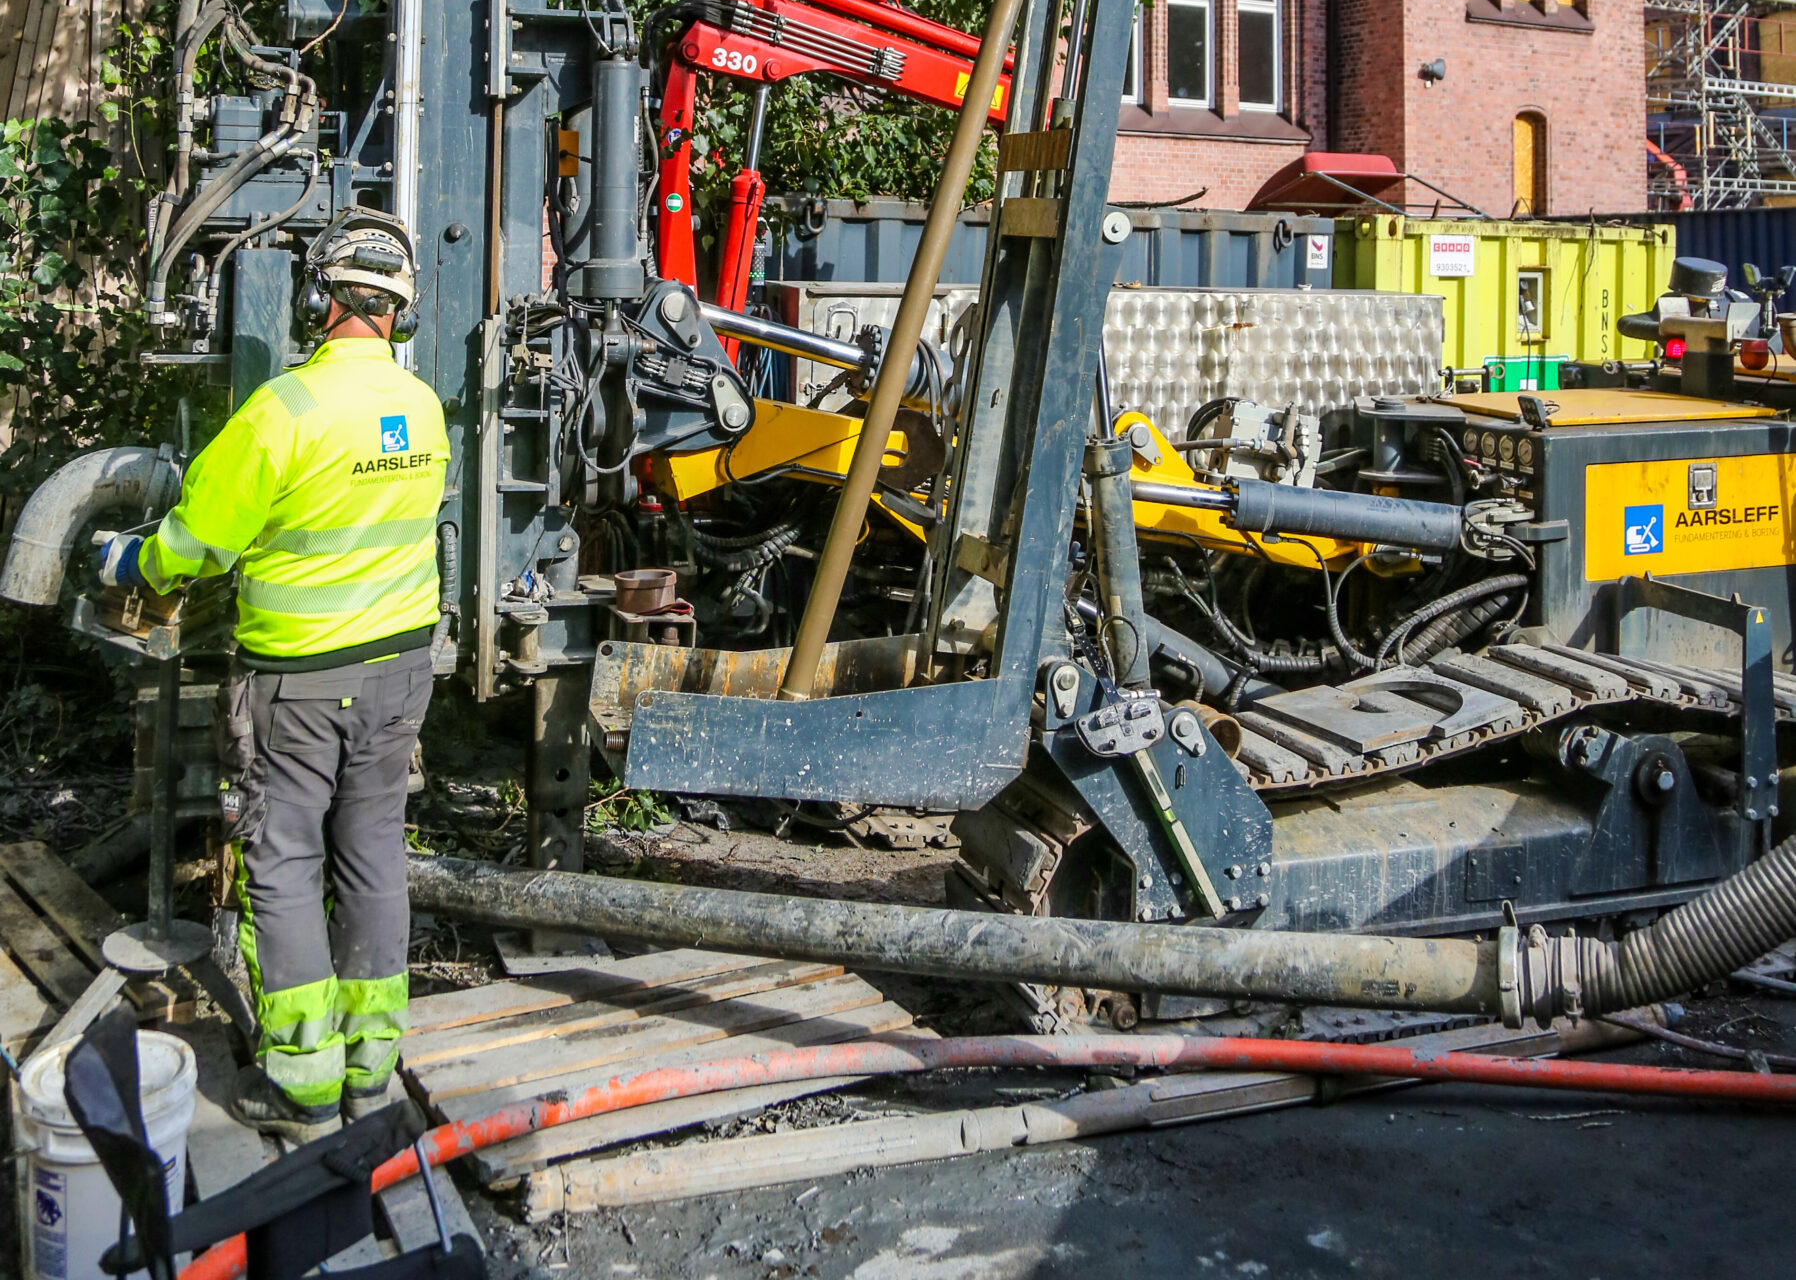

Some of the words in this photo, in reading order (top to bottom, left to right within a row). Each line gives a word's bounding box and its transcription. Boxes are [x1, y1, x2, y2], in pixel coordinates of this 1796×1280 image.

[711, 47, 757, 74] 330
[1601, 288, 1609, 360] BNS
[352, 453, 432, 475] AARSLEFF
[1675, 505, 1779, 528] AARSLEFF
[1674, 528, 1743, 543] FUNDAMENTERING
[1744, 528, 1750, 538] &
[1752, 526, 1780, 538] BORING
